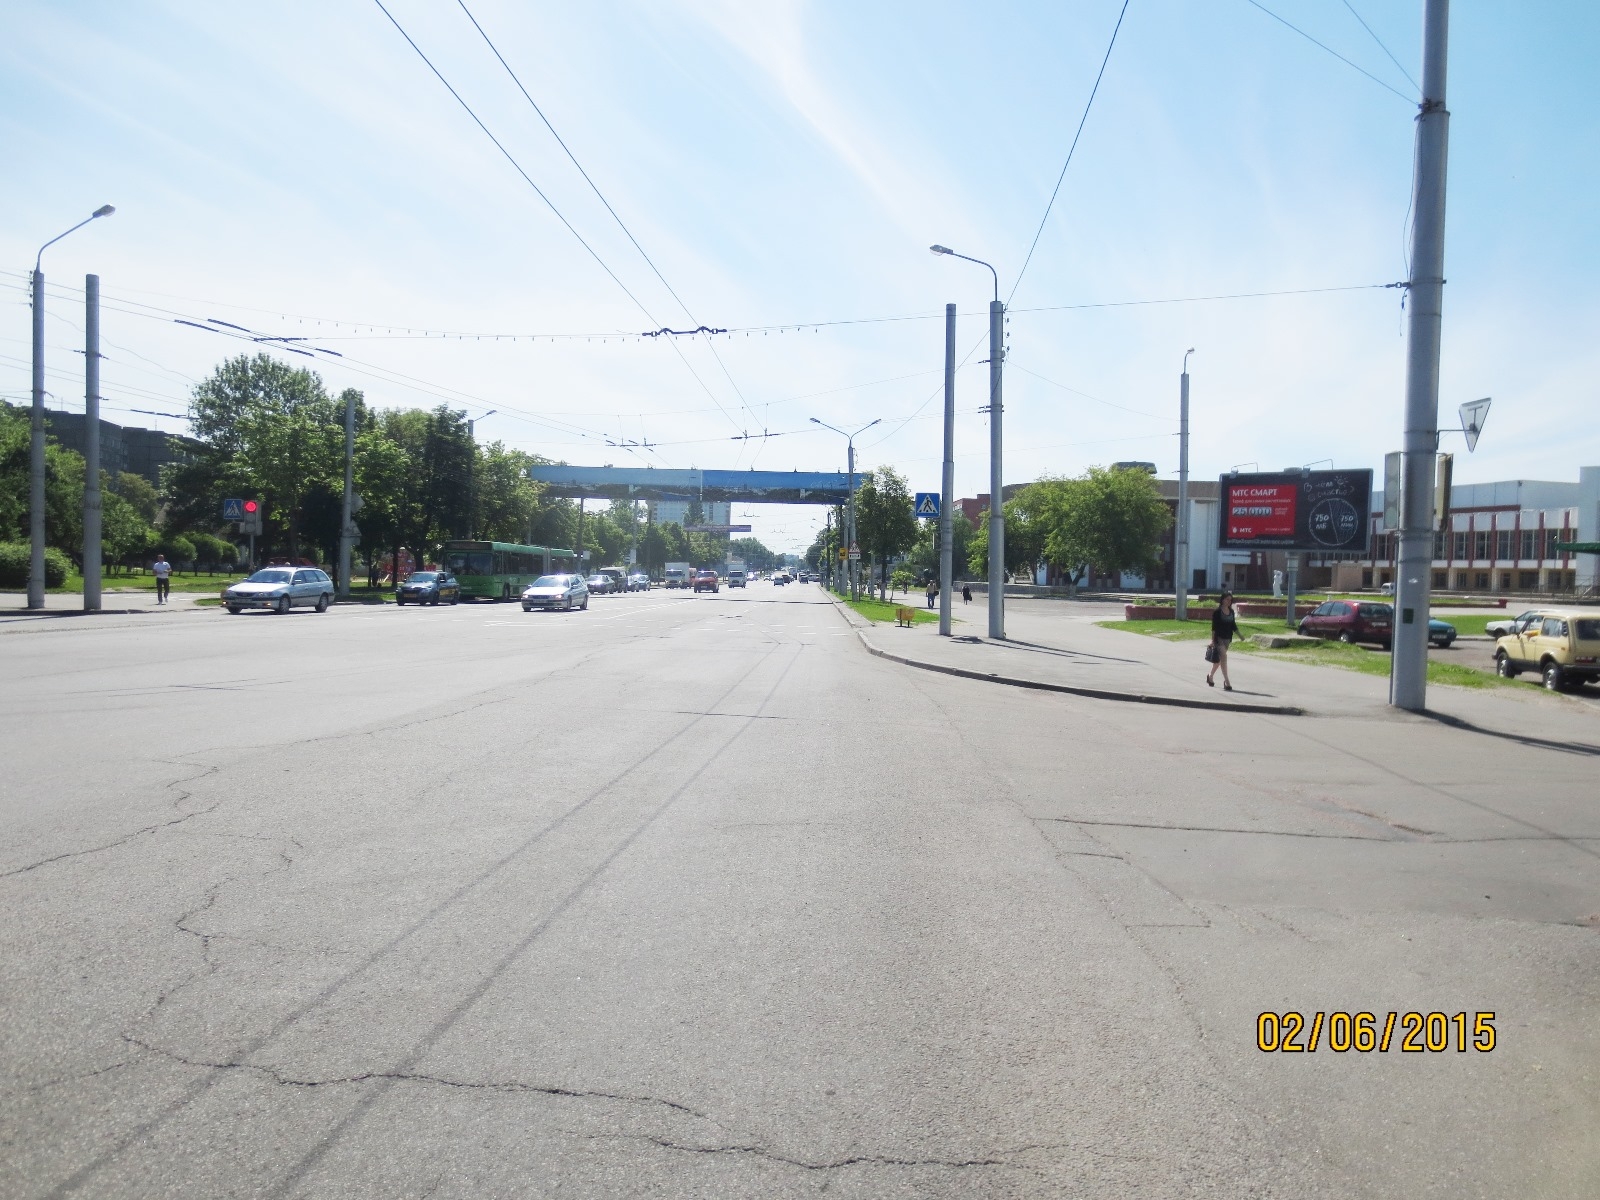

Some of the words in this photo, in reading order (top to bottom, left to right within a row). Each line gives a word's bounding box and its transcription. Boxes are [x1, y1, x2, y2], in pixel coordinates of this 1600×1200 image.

[1232, 489, 1249, 497] МТС
[1250, 488, 1278, 497] СМАРТ
[1315, 514, 1329, 522] 750
